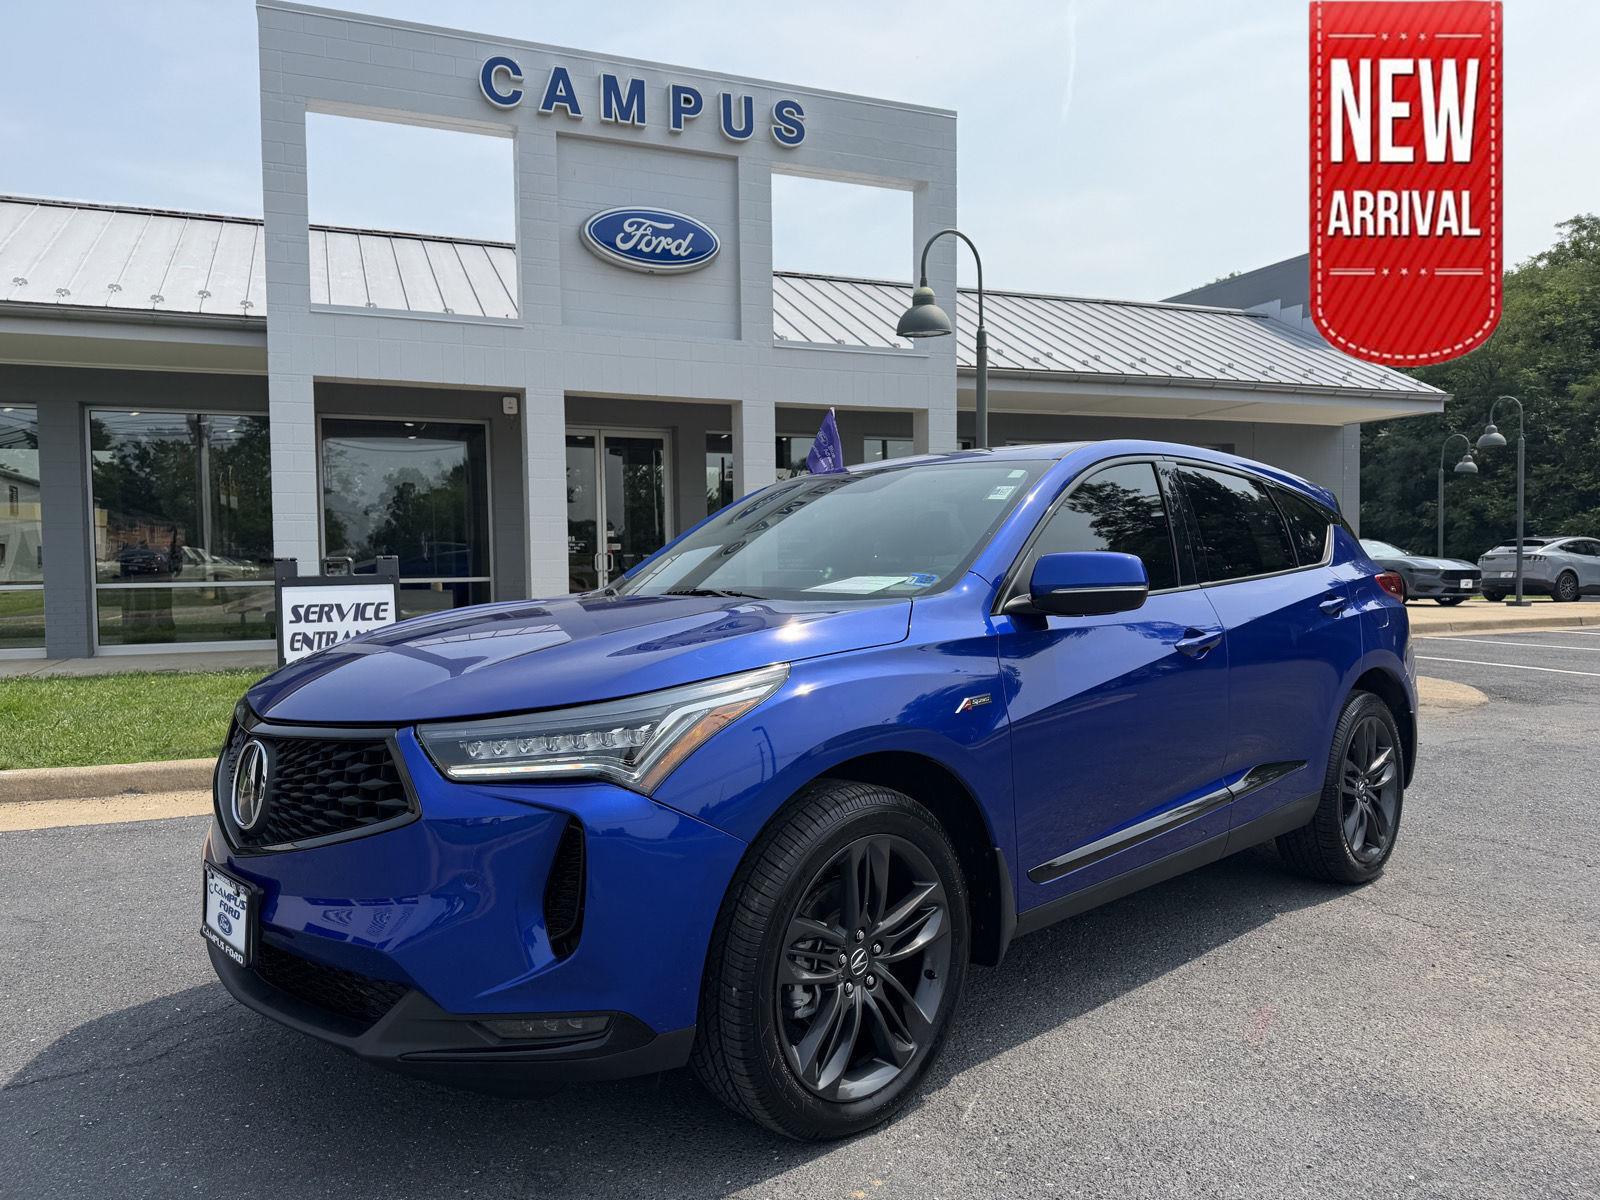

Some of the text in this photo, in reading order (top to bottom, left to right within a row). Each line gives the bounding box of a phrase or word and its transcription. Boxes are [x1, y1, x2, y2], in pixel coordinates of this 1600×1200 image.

[479, 56, 807, 148] CAMPUS
[615, 218, 694, 257] Ford
[289, 602, 389, 624] SERVICE
[219, 899, 241, 921] FORD
[202, 925, 244, 965] CAMPUS FORD
